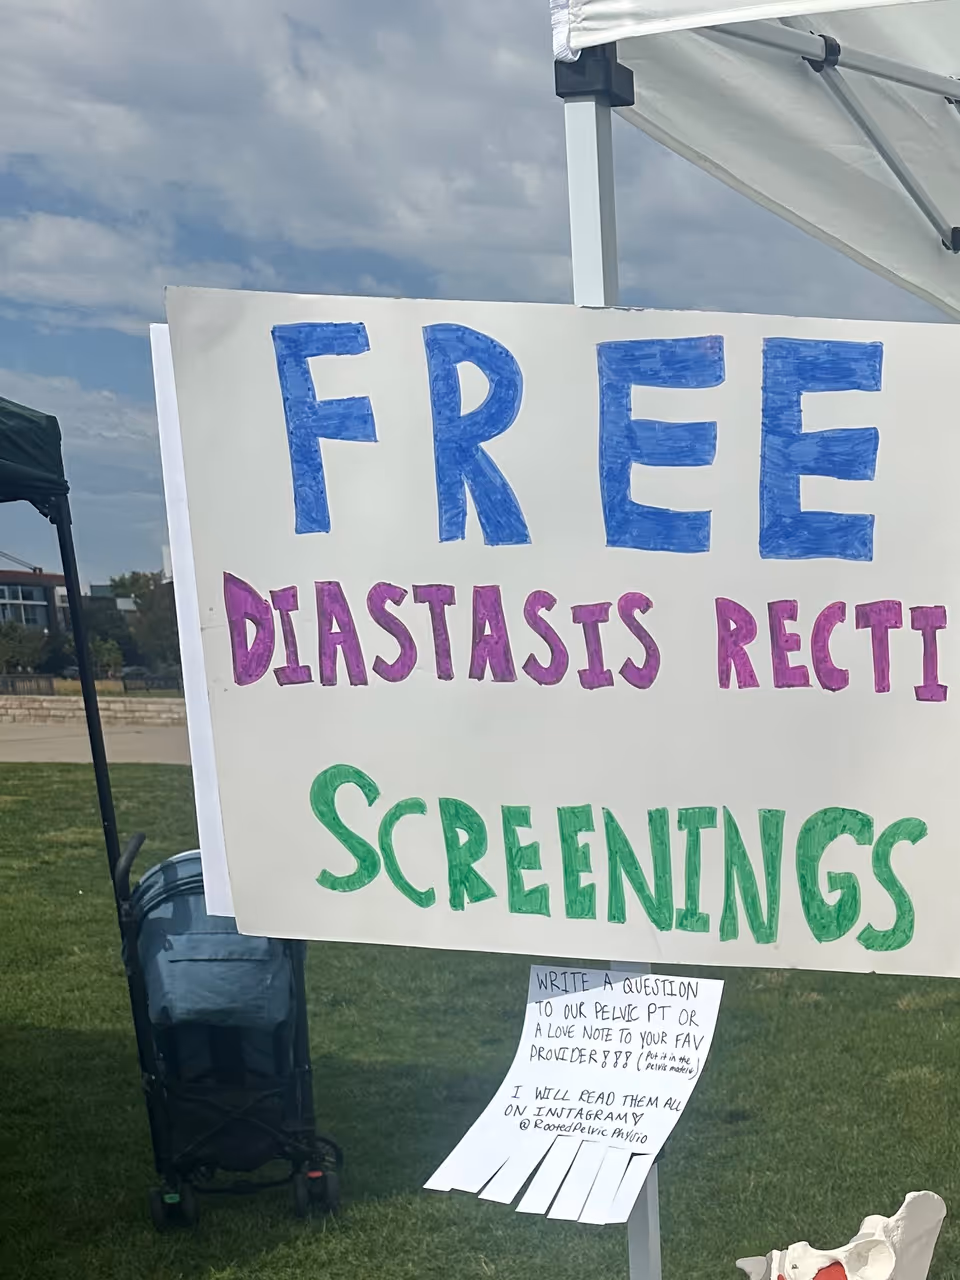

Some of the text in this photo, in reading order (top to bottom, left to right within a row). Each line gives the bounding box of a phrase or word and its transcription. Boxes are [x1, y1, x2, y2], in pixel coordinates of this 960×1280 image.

[271, 321, 884, 562] FREE
[223, 571, 949, 703] DIASTASIS RECTI
[310, 763, 929, 952] SCREENINGS
[536, 971, 699, 1001] WRITE A QUESTION
[535, 1001, 700, 1027] TO OUR PELVIC PT OR
[534, 1022, 705, 1051] A LOVE NOTE TO YOUR FAV
[660, 1052, 668, 1061] it
[669, 1052, 676, 1062] in
[678, 1054, 691, 1065] the
[511, 1085, 683, 1112] I WILL READ THEM ALL
[504, 1104, 628, 1124] ON INSTAGRAM
